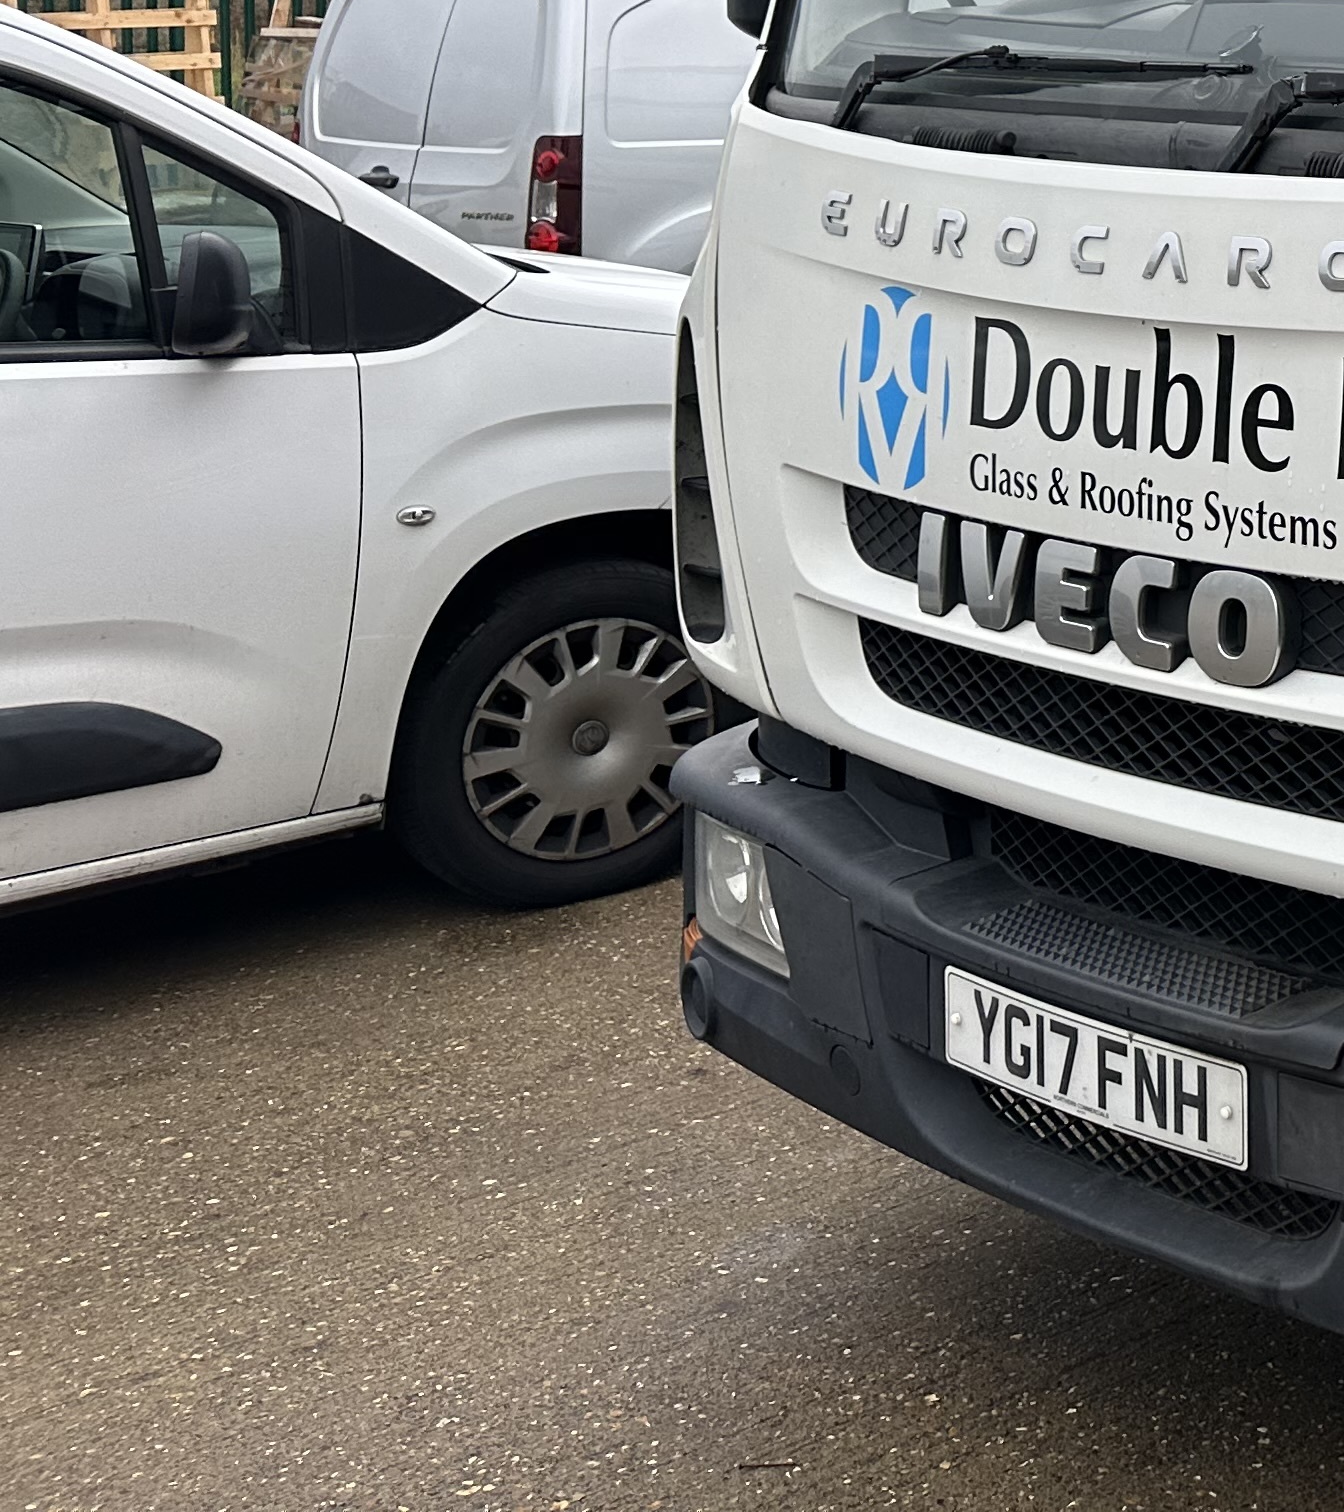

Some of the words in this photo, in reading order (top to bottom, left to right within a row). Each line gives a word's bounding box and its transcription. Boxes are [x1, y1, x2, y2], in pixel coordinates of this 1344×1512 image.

[969, 315, 1295, 474] Double
[969, 453, 1038, 501] Glass
[1048, 466, 1070, 507] &
[1080, 471, 1194, 541] Roofing
[1204, 490, 1337, 549] Systems
[916, 511, 1286, 687] IVECO
[974, 988, 1079, 1095] YG17
[1097, 1034, 1208, 1142] FNH
